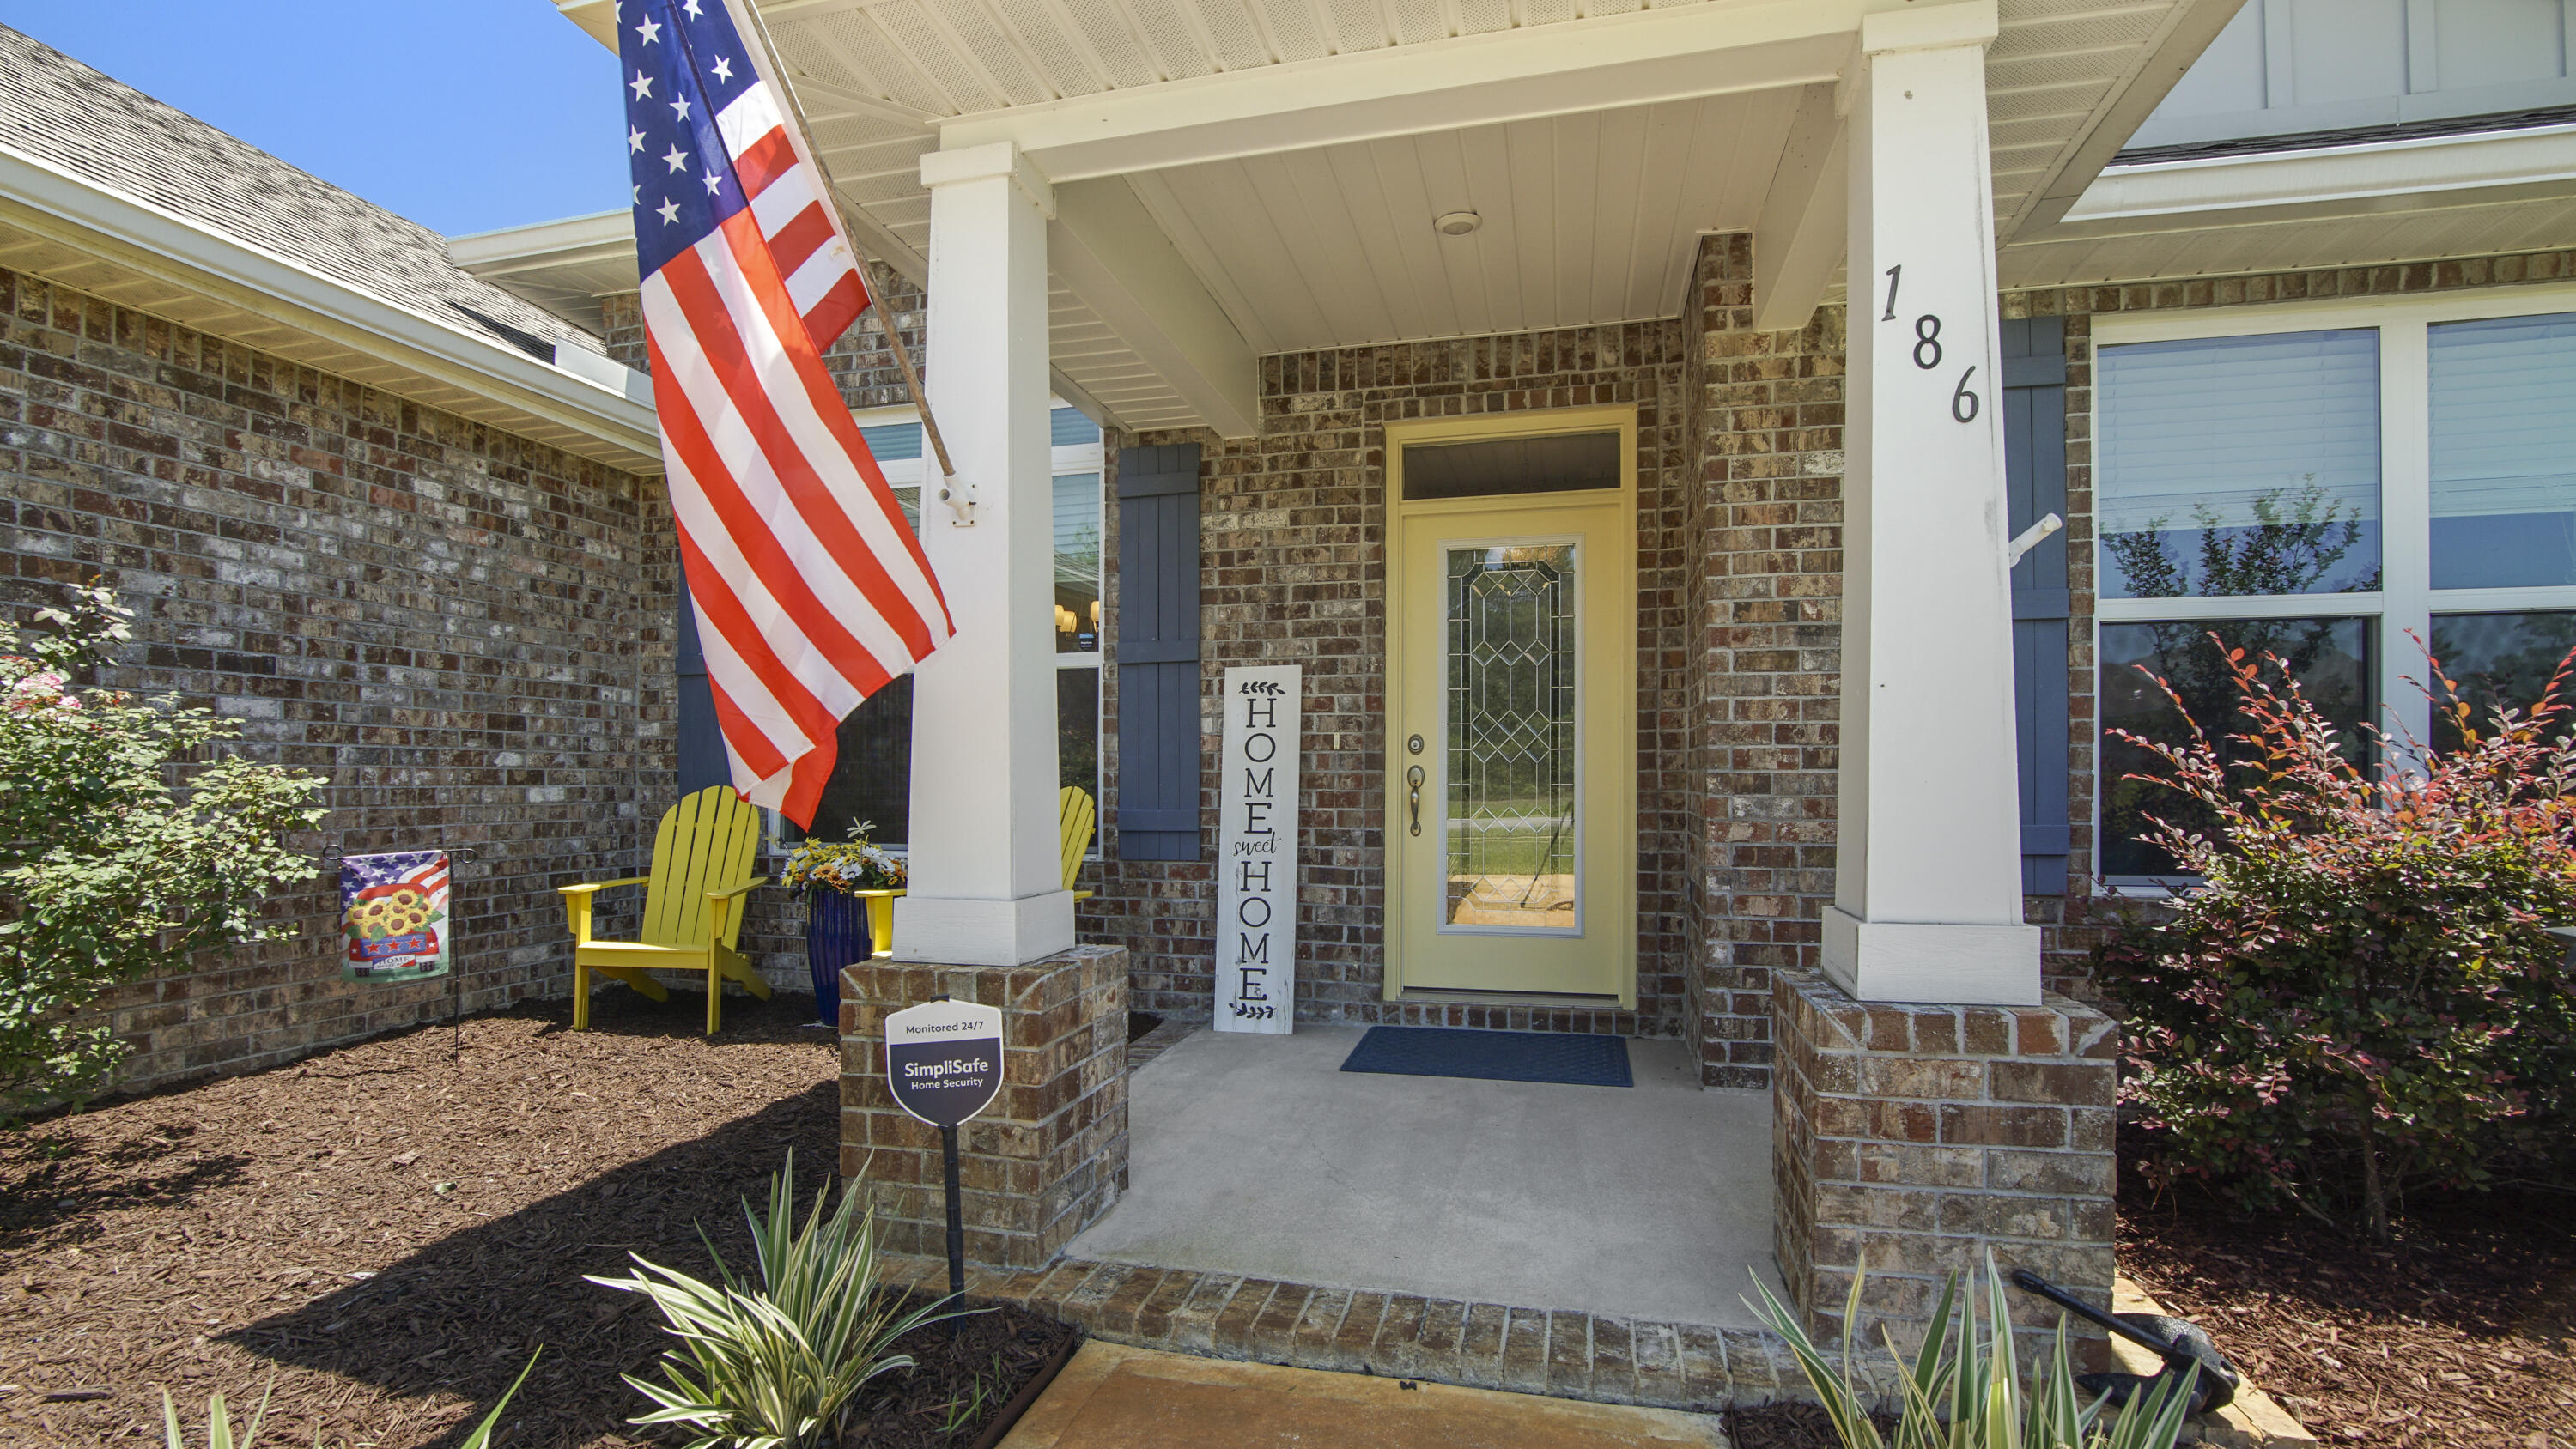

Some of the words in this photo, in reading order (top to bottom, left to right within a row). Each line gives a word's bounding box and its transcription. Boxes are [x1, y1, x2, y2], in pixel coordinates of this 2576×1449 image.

[1881, 264, 1979, 423] 186
[1243, 698, 1277, 834] HOME
[1233, 831, 1282, 857] sweet
[1238, 861, 1272, 1001] HOME
[378, 955, 410, 965] HOME
[906, 1022, 958, 1034] Monitored
[961, 1021, 984, 1031] 24/7
[904, 1058, 989, 1079] SimpliSafe
[911, 1080, 941, 1090] Home
[943, 1077, 984, 1088] Security
